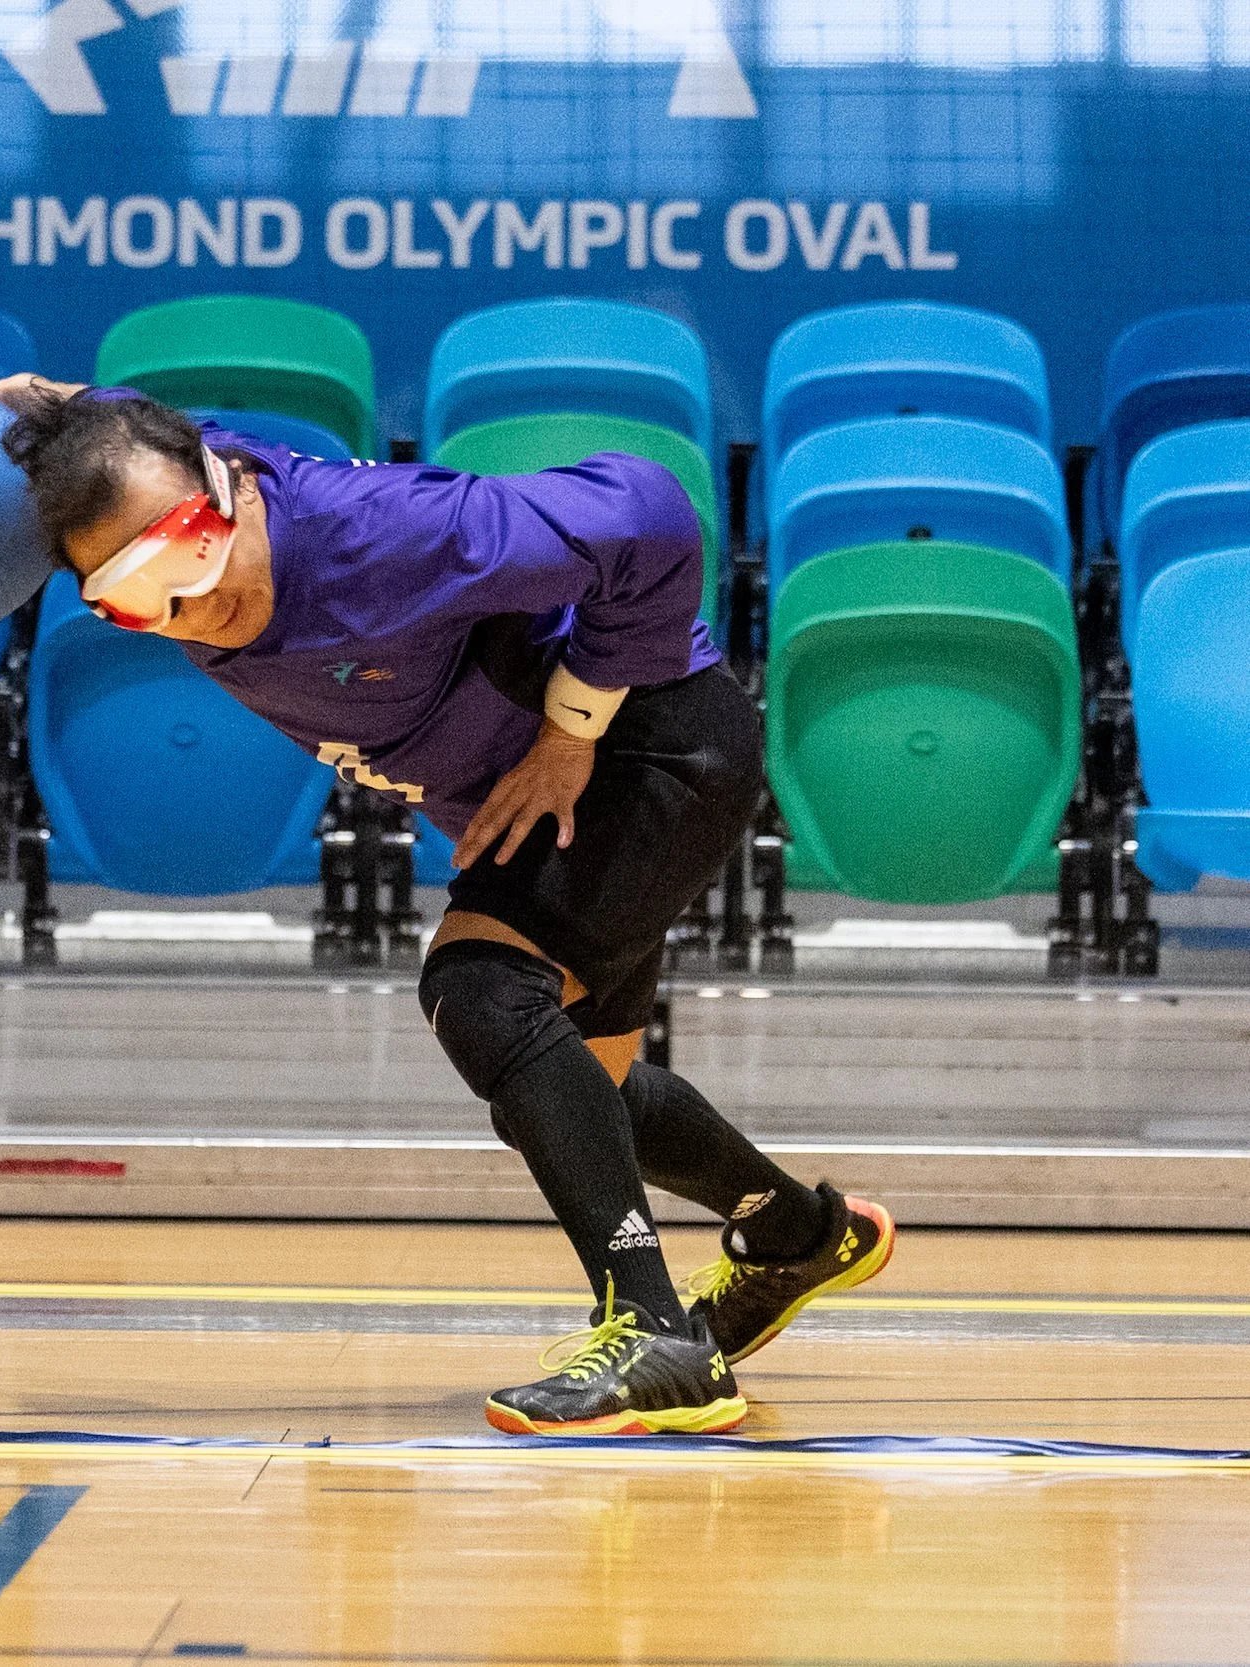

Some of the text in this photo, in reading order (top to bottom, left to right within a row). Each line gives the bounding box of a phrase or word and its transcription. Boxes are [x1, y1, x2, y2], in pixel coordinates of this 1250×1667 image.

[325, 198, 702, 269] OLYMPIC
[724, 200, 957, 271] OVAL
[608, 1233, 658, 1251] adidas
